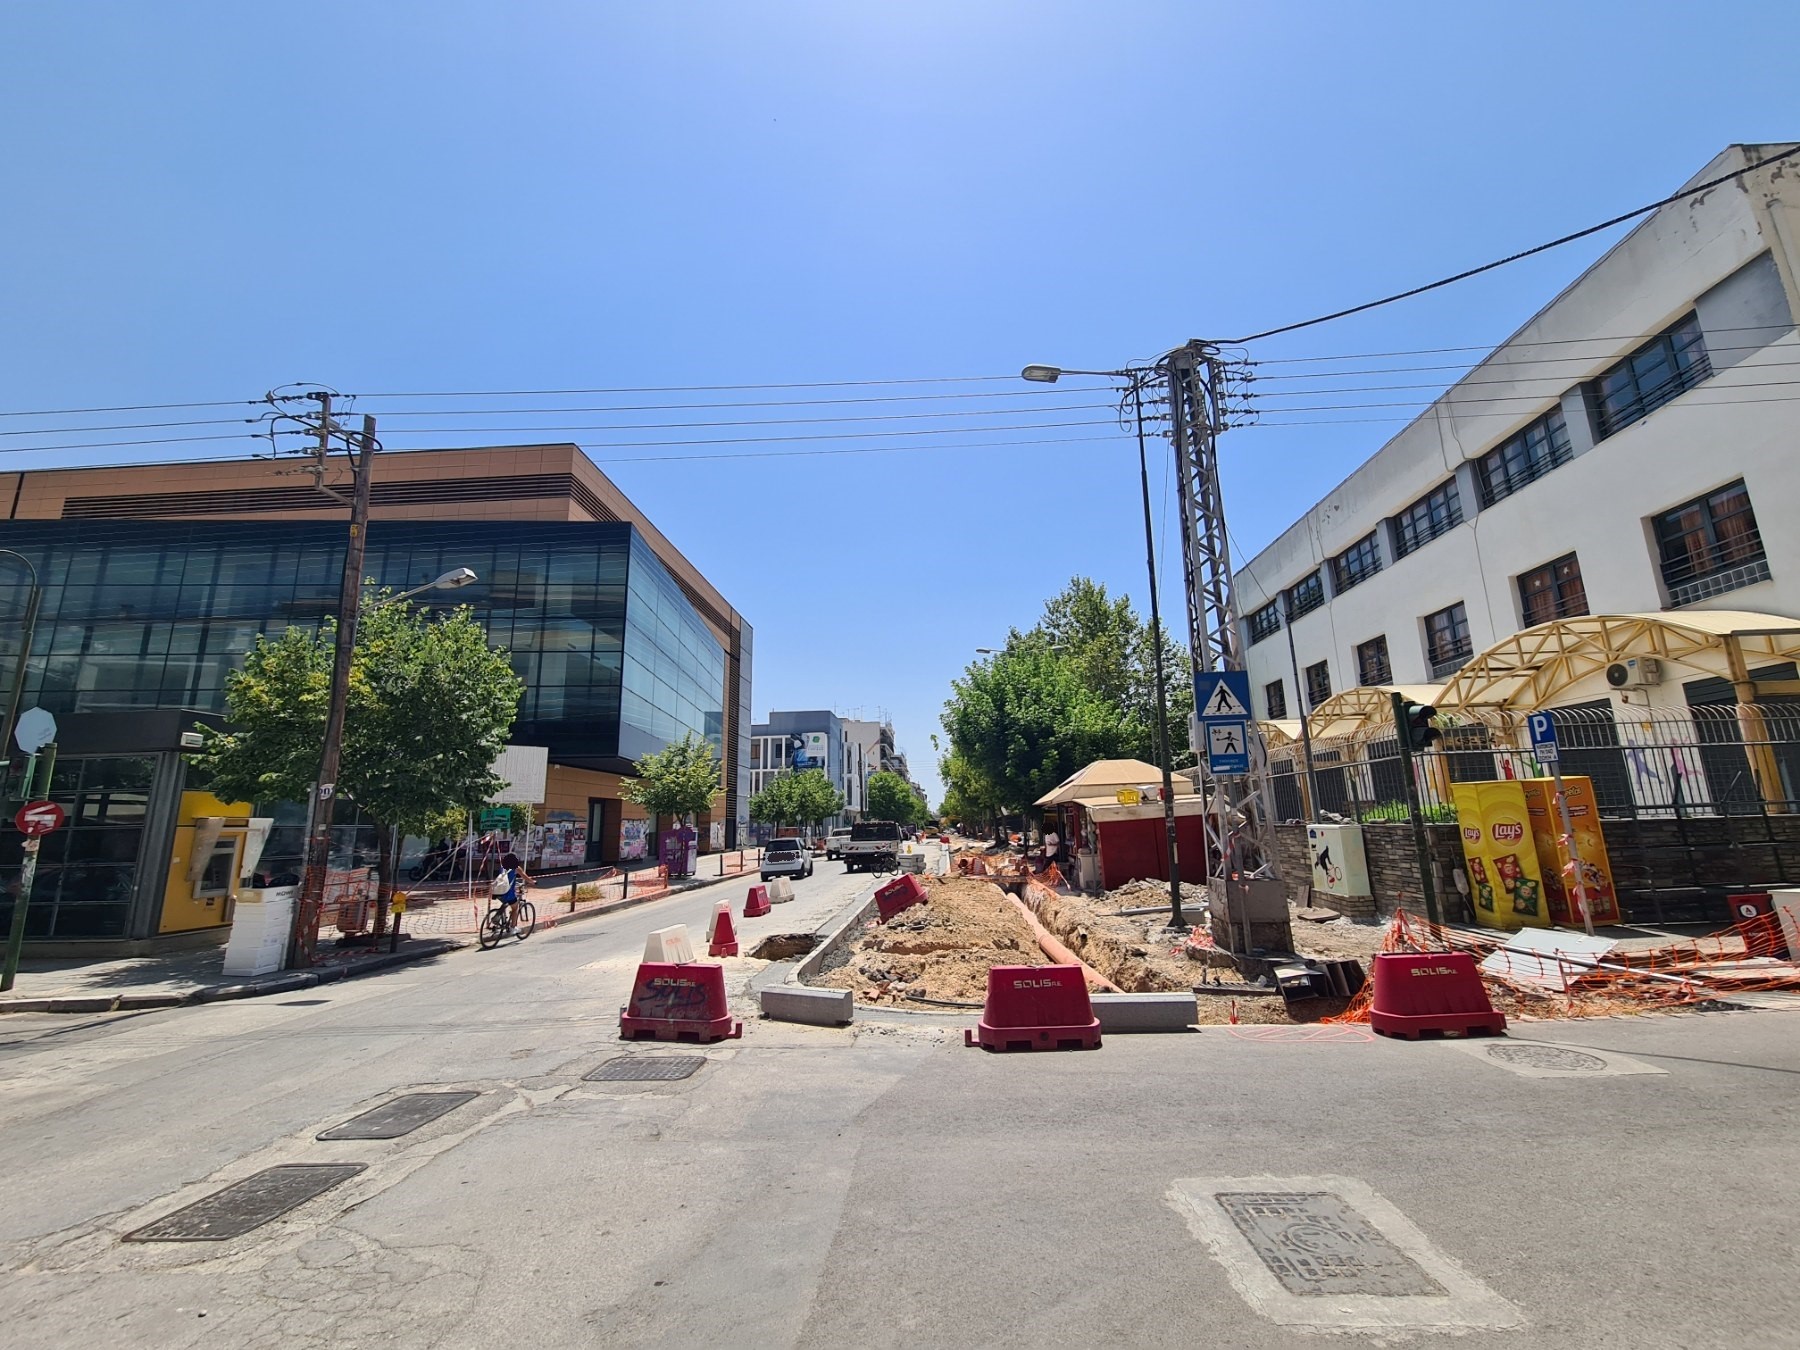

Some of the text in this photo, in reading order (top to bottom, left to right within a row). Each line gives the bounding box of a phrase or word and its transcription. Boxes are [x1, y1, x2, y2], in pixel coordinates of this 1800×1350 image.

[1532, 715, 1548, 741] P
[1410, 966, 1448, 977] SOLIS
[653, 977, 687, 987] SOLIS
[1013, 978, 1051, 989] SOLIS
